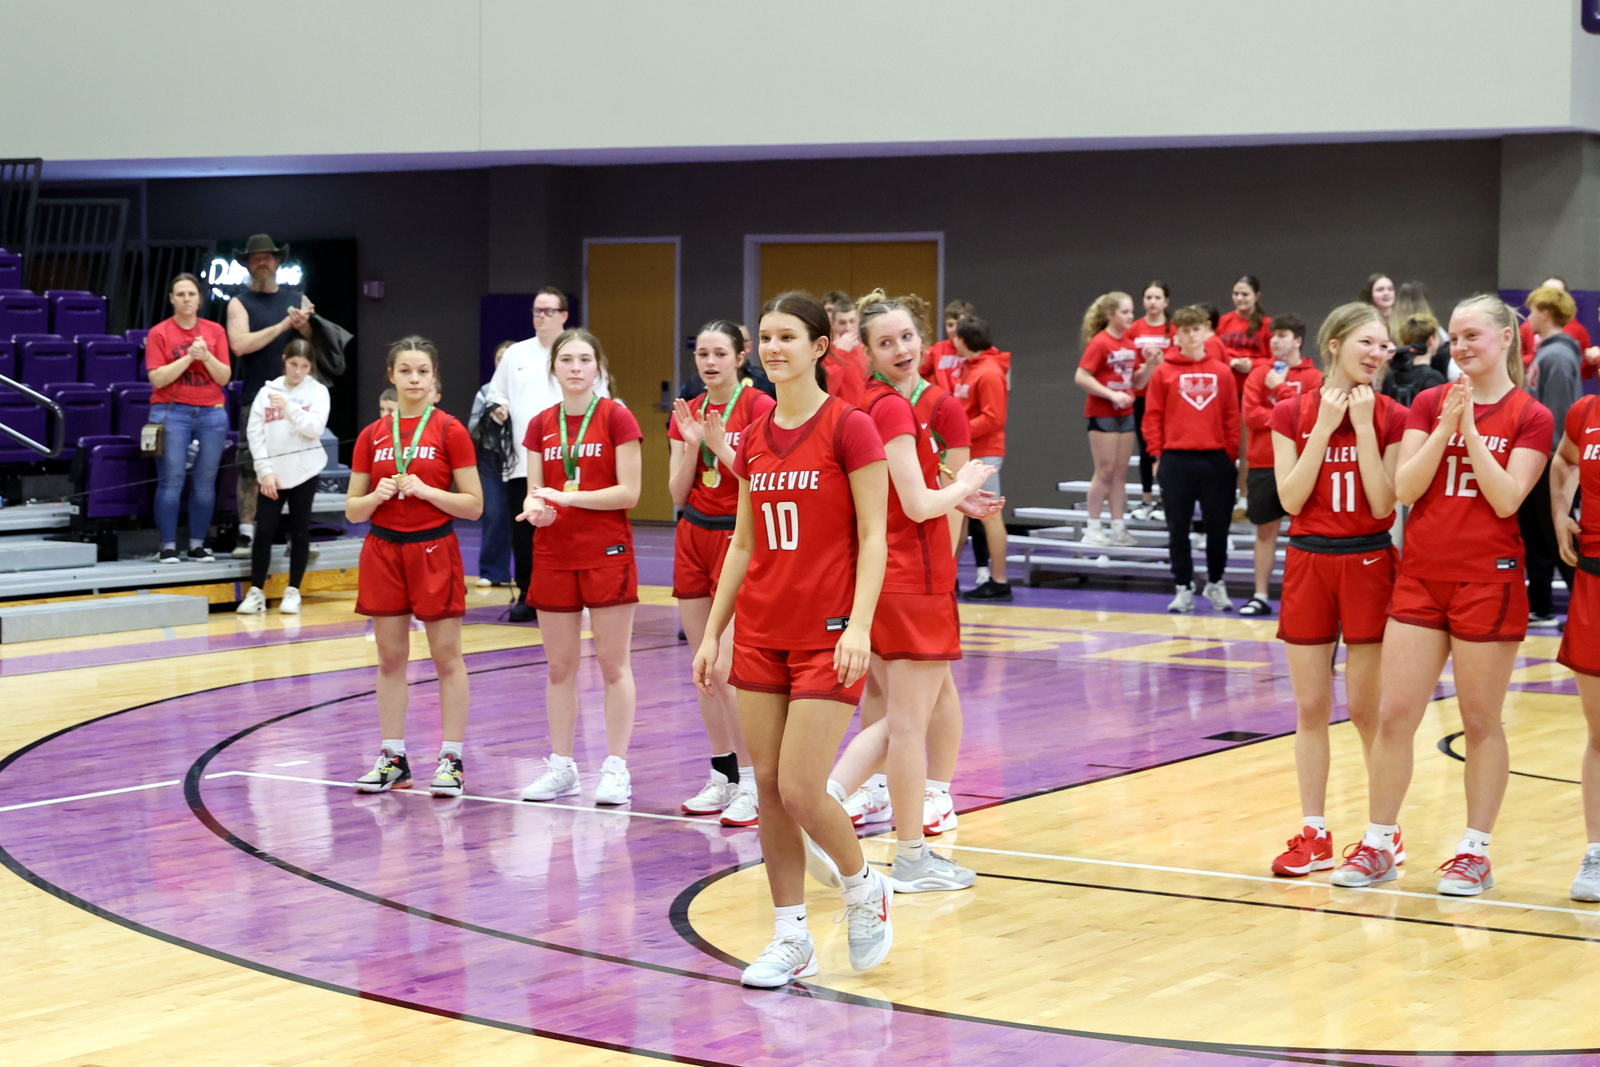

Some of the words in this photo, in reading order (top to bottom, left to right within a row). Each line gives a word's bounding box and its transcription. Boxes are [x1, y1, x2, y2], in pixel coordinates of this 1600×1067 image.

[373, 445, 437, 463] BELEVUE
[544, 443, 603, 462] BELVUE
[1447, 432, 1509, 454] LLUE
[1324, 446, 1358, 463] LLEV
[1444, 455, 1478, 498] 12
[1330, 471, 1356, 513] 11
[761, 501, 799, 551] 10
